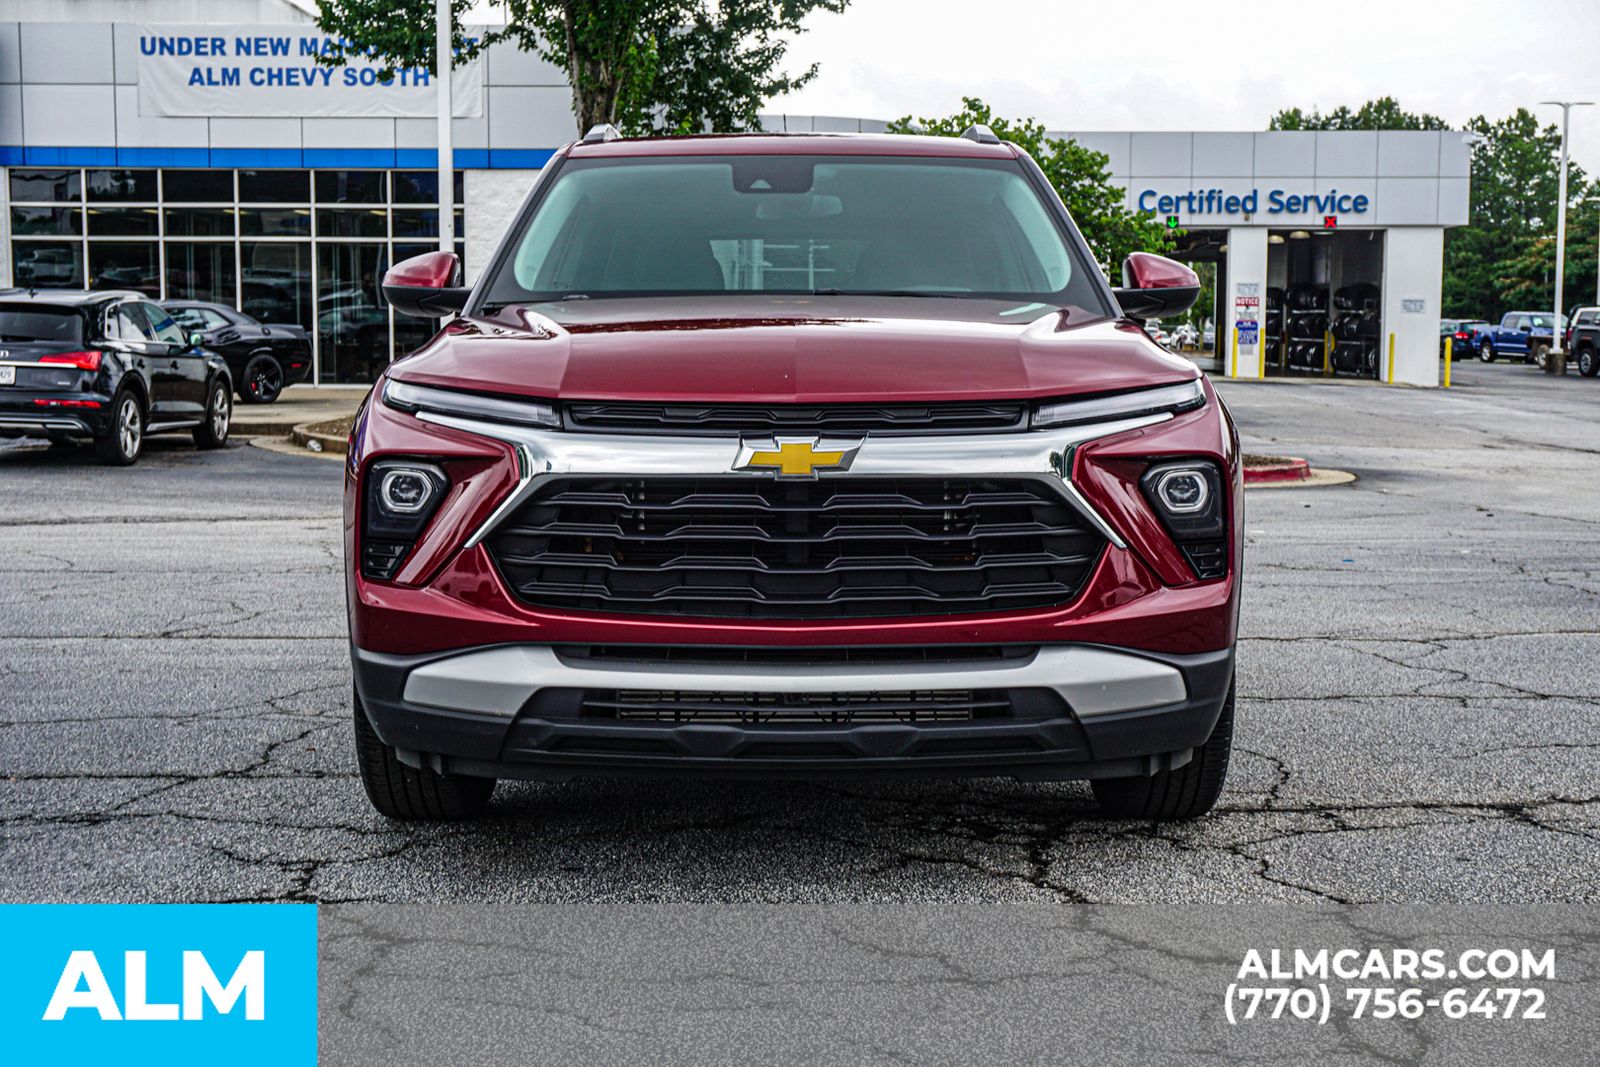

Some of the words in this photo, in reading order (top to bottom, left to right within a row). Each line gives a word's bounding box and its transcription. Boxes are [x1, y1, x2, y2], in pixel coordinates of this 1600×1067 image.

[140, 36, 227, 56] UNDER
[235, 37, 291, 56] NEW
[188, 67, 240, 86] ALM
[249, 67, 334, 86] CHEVY
[1138, 189, 1258, 214] Certified
[1267, 189, 1369, 214] Service
